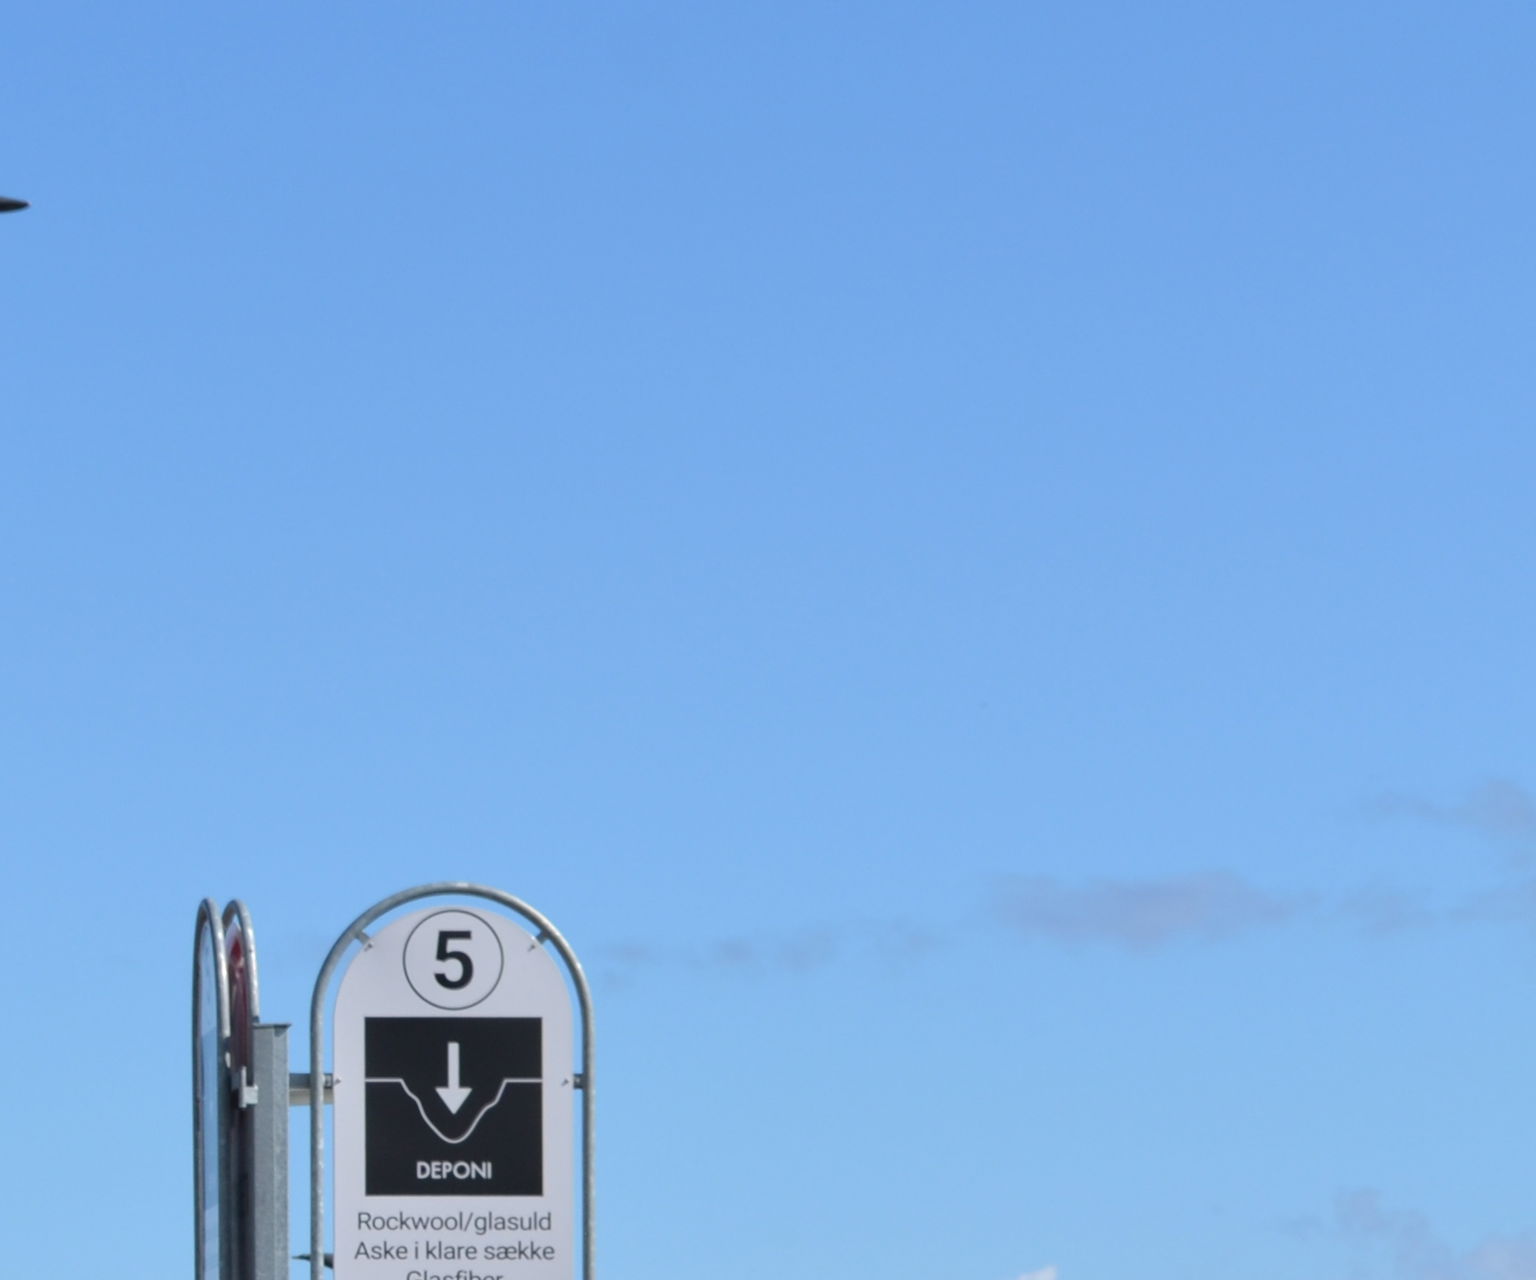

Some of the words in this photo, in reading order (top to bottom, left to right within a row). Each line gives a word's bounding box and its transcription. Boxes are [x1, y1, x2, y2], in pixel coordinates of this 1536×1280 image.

[434, 930, 474, 990] 5
[416, 1161, 493, 1179] DEPONI
[357, 1211, 553, 1235] Rockwool/glasuld
[354, 1241, 409, 1260] Aske
[414, 1241, 419, 1260] i
[425, 1240, 478, 1260] klare
[483, 1241, 556, 1261] sække
